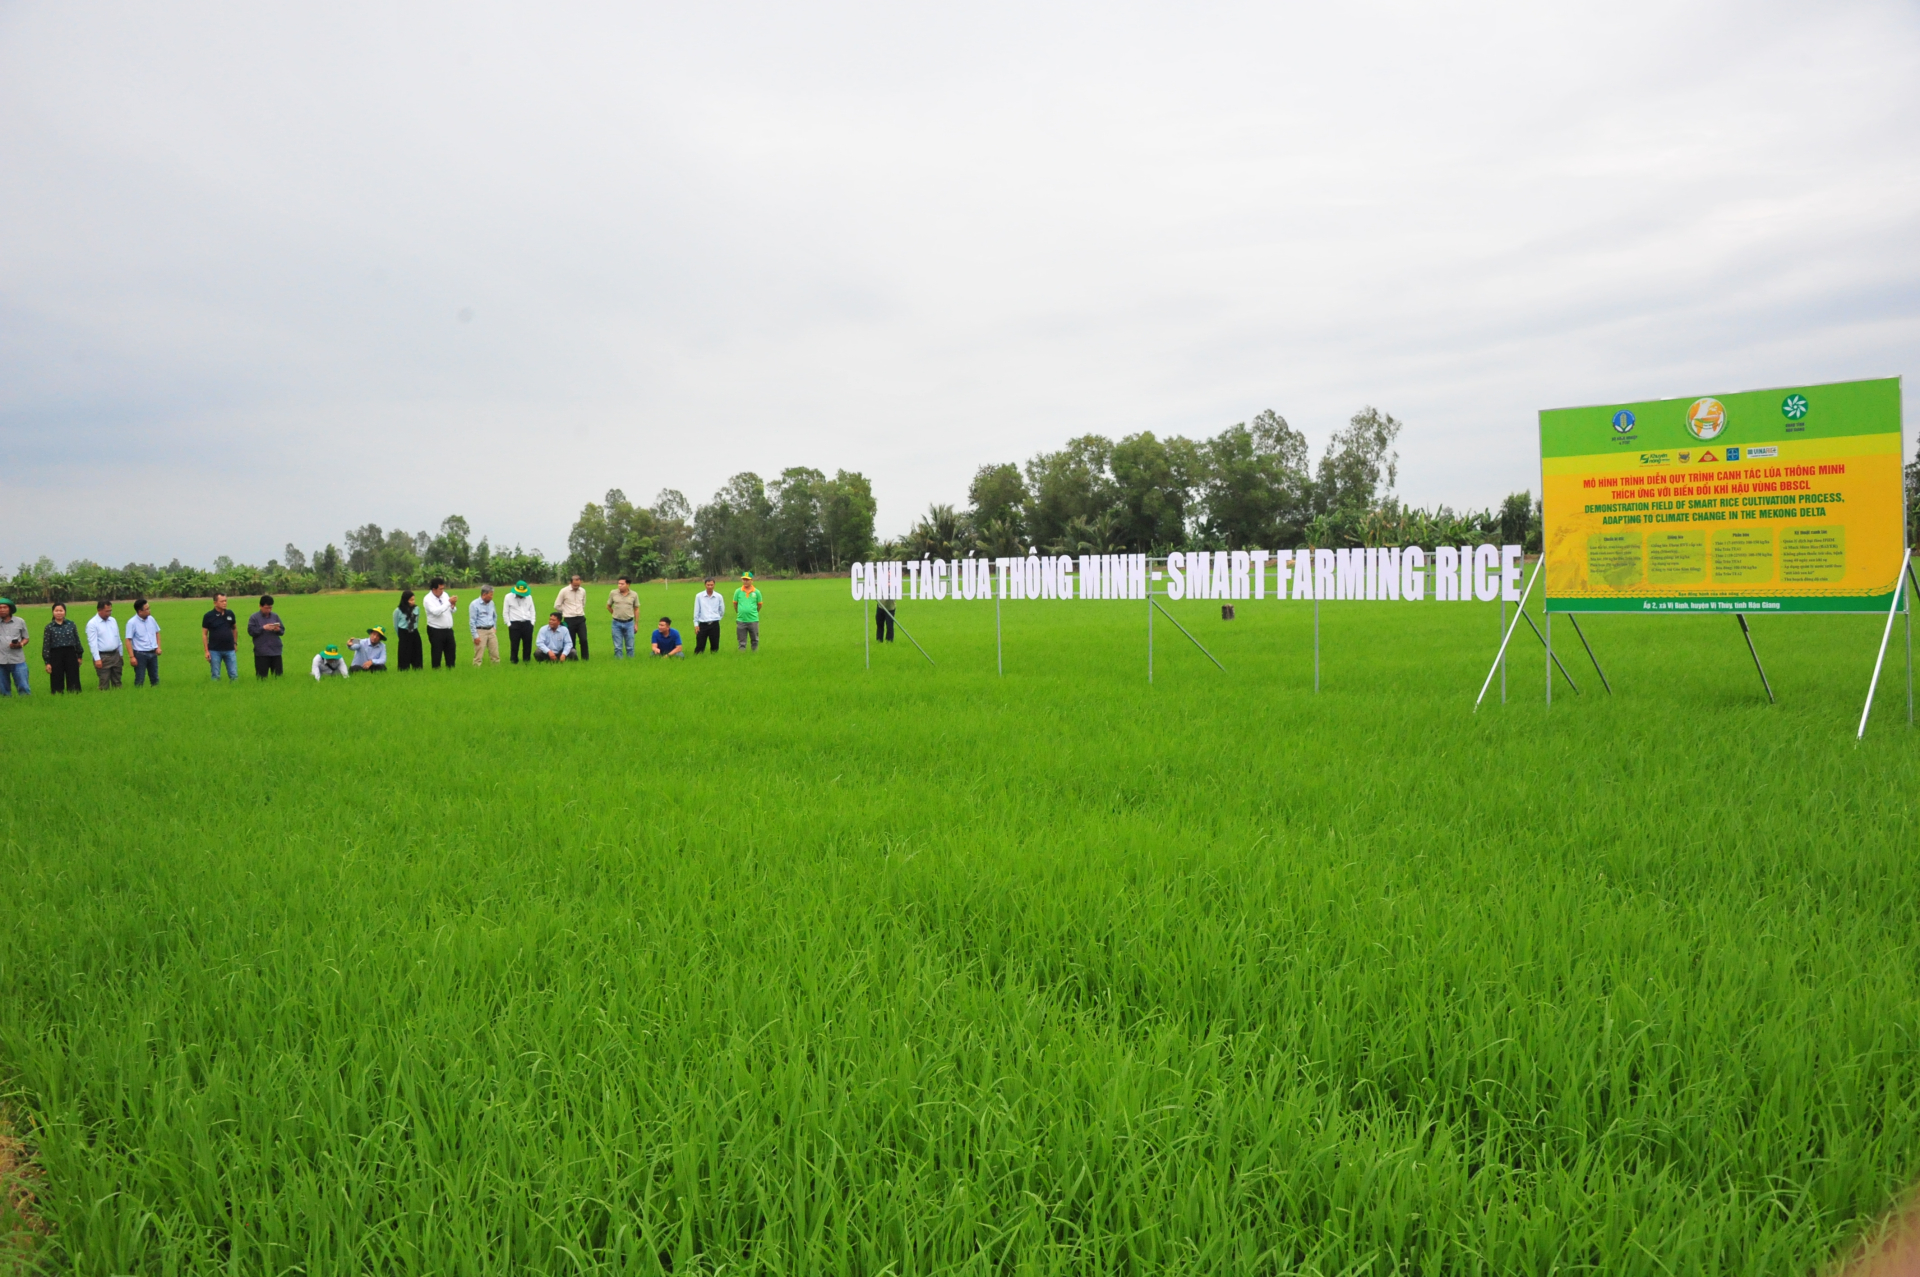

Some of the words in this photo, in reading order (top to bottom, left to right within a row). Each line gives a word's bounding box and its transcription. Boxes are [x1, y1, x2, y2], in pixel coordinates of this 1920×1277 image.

[1598, 476, 1618, 488] HÌNH
[1620, 475, 1644, 486] TRÌNH
[1669, 474, 1686, 484] QUY
[1688, 471, 1714, 482] TRÌNH
[1717, 470, 1741, 481] CANH
[1744, 467, 1761, 479] TÁC
[1764, 466, 1781, 478] LÚA
[1784, 465, 1816, 477] THÔNG
[1818, 464, 1845, 475] MINH
[1612, 488, 1635, 500] THÍCH
[1638, 487, 1655, 498] ỨNG
[1657, 486, 1671, 497] VỚI
[1714, 483, 1728, 495] KHÍ
[1731, 482, 1750, 495] HẬU
[1752, 481, 1777, 492] VÙNG
[1780, 480, 1811, 491] ĐBSCL
[1584, 502, 1649, 513] DEMONSTRATION
[1652, 501, 1673, 510] FIELD
[1676, 500, 1686, 510] OF
[1688, 498, 1718, 509] SMART
[1720, 498, 1739, 508] RICE
[1742, 495, 1796, 506] CULTIVATION
[1798, 492, 1845, 504] PROCESS,
[1602, 515, 1641, 525] ADAPTING
[1644, 514, 1653, 523] TO
[1656, 513, 1690, 523] CLIMATE
[1692, 511, 1726, 522] CHANGE
[1729, 511, 1738, 520] IN
[1741, 510, 1756, 519] THE
[1759, 508, 1797, 519] MEKONG
[1800, 507, 1826, 517] DELTA
[851, 562, 902, 600] CANH
[907, 552, 946, 600] TÁC
[951, 550, 992, 600] LÚA
[996, 546, 1073, 600] THÔNG
[1079, 553, 1146, 599] MINH
[1167, 550, 1269, 600] SMART
[1277, 546, 1425, 601] FARMING
[1435, 544, 1522, 602] RICE
